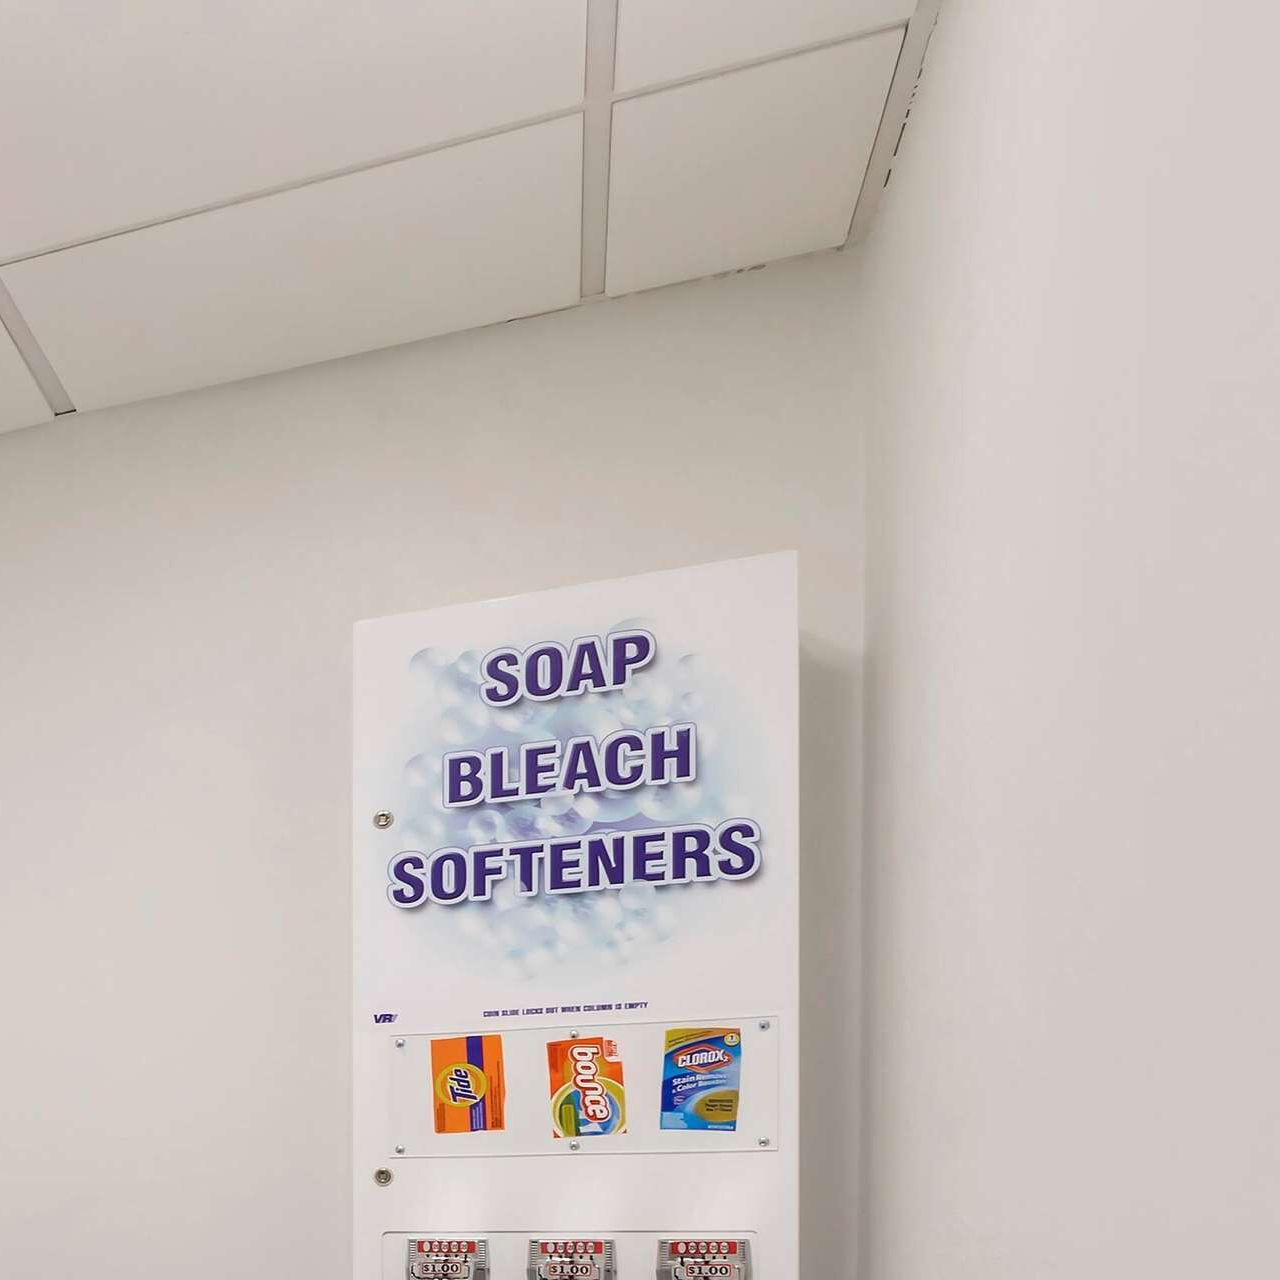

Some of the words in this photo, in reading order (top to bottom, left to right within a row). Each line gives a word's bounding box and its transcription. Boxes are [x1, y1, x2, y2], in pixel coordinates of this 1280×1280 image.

[483, 631, 654, 705] SOAP
[445, 725, 694, 807] BLEACH
[391, 821, 759, 907] SOFTENERS
[448, 1067, 479, 1103] Tide
[571, 1045, 610, 1121] bounce
[672, 1075, 696, 1086] Stain
[676, 1082, 698, 1092] Color
[423, 1264, 459, 1273] $1.00
[550, 1265, 589, 1275] $1.00
[688, 1266, 729, 1276] $1.00
